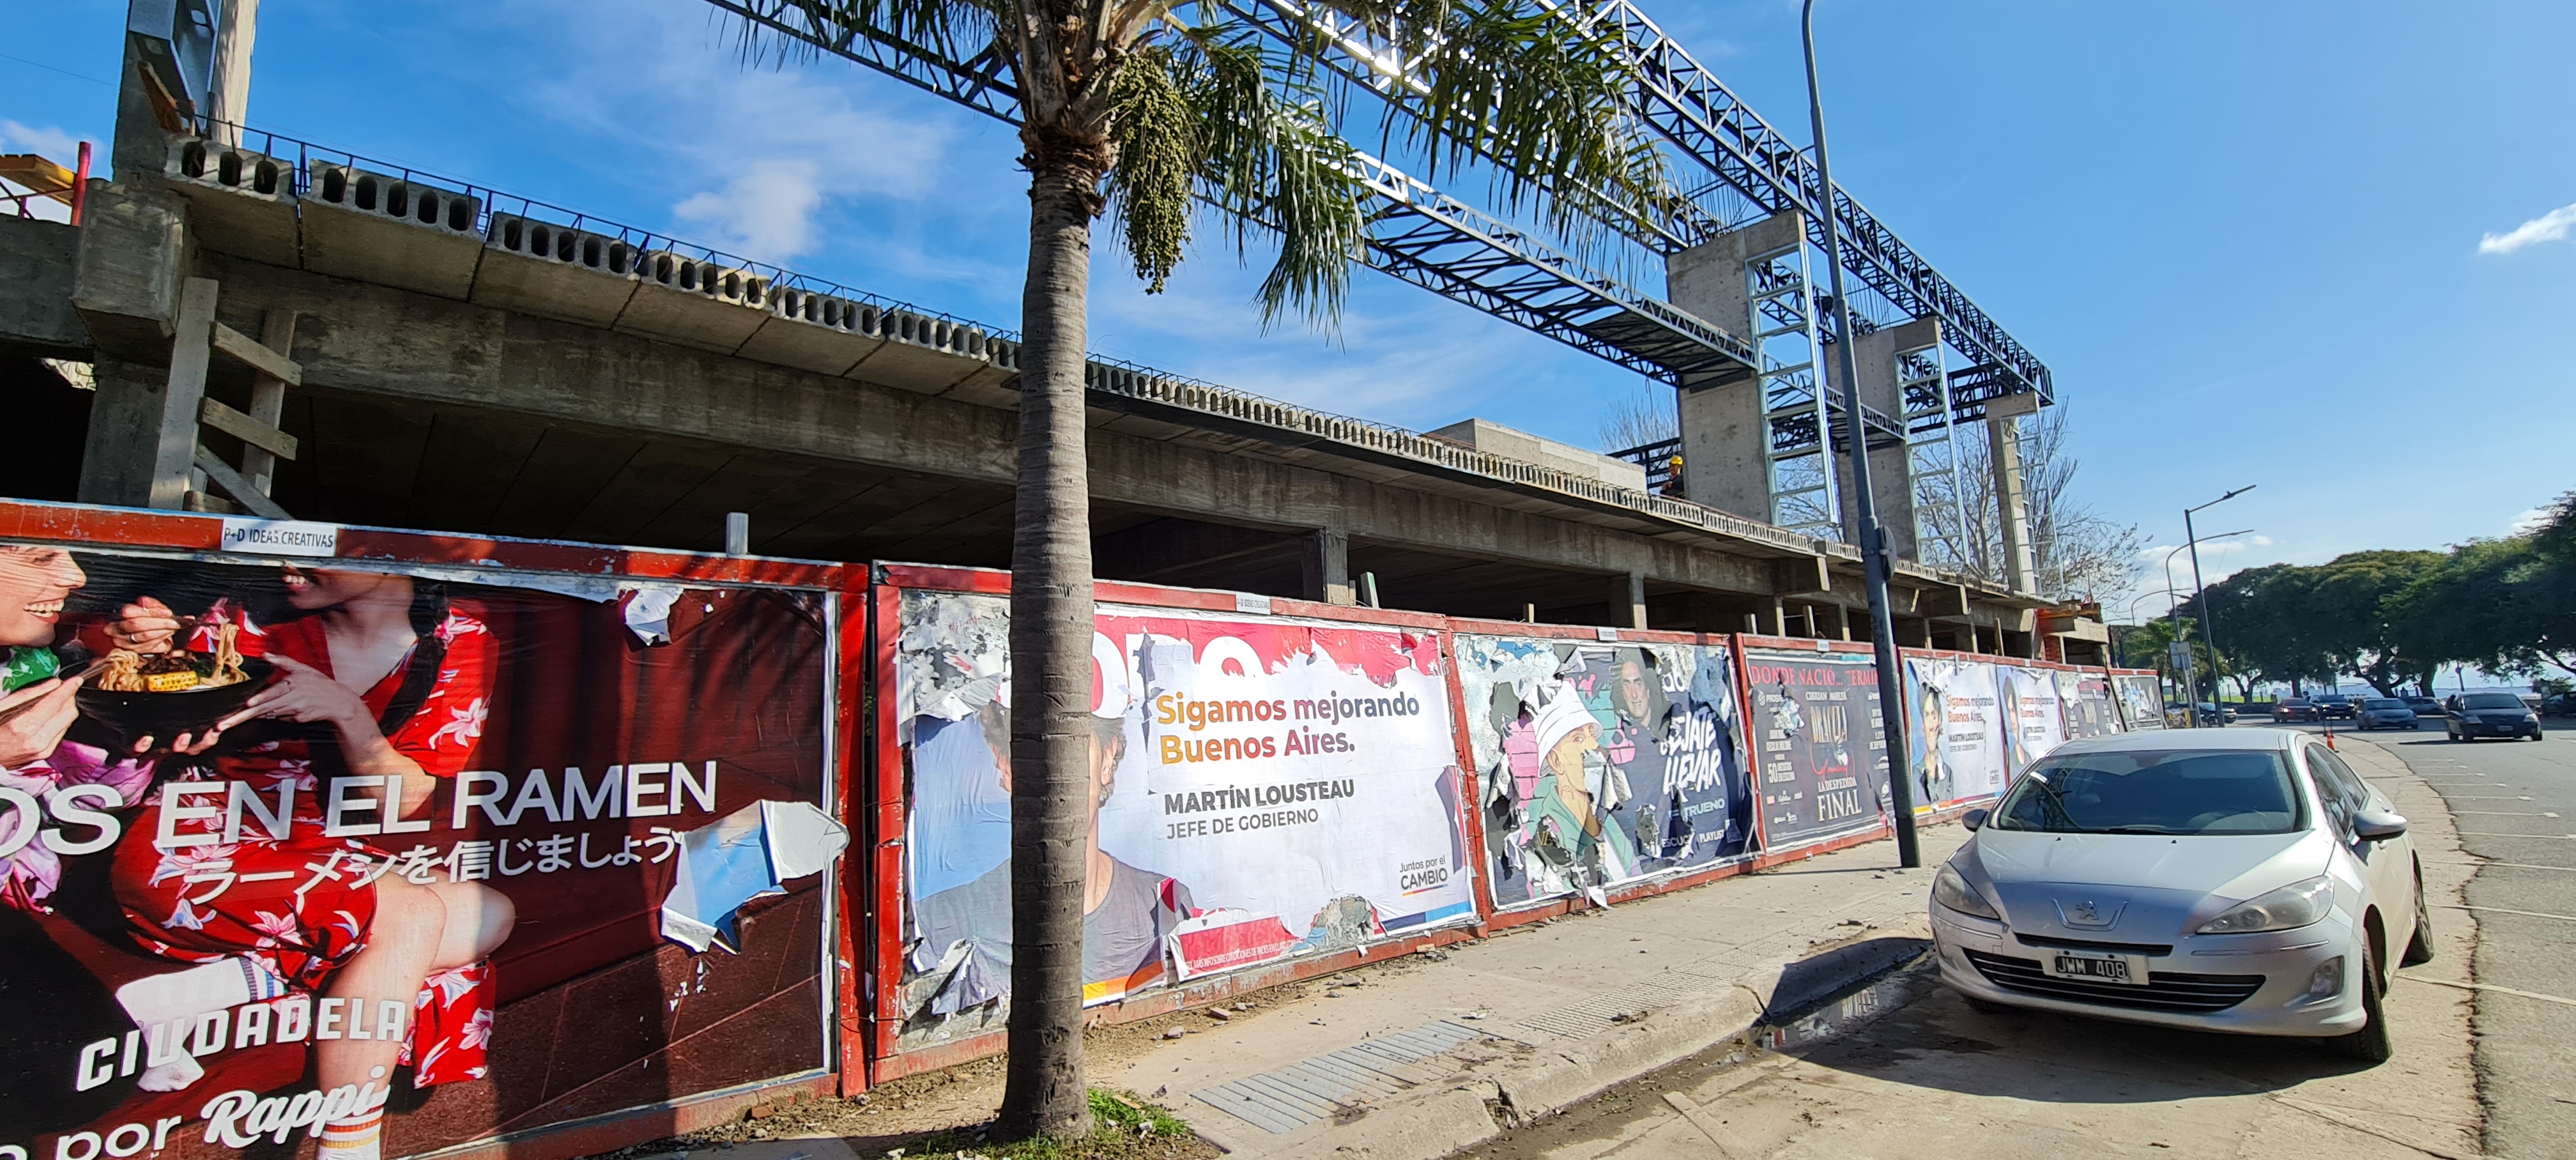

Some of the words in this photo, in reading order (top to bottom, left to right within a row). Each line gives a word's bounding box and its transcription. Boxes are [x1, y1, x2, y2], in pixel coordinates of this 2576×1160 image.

[249, 529, 279, 544] IDEAS
[281, 531, 334, 548] CREATIVAS
[1157, 692, 1287, 731] Sigamos
[1294, 690, 1420, 725] mejorando
[1160, 729, 1276, 765] Buenos
[1284, 726, 1356, 756] Aires.
[1768, 763, 1778, 783] 50
[155, 778, 296, 848] EN
[325, 774, 431, 837] EL
[452, 760, 717, 830] RAMEN
[1165, 785, 1252, 815] MARTÍN
[1256, 779, 1355, 807] LOUSTEAU
[1683, 798, 1725, 817] TRUENO
[1817, 789, 1862, 822] FINAL
[1167, 822, 1208, 839] JEFE
[1213, 818, 1235, 834] DE
[1238, 808, 1319, 831] GOBIERNO
[1661, 834, 1692, 848] ESCUC
[1699, 829, 1724, 843] PLAYLIST
[1400, 861, 1424, 873] Juntos
[1425, 859, 1438, 869] por
[1439, 855, 1446, 865] el
[1401, 867, 1448, 890] CAMBIO
[2096, 960, 2126, 978] 408
[75, 996, 408, 1092] CIUDADELA
[54, 1115, 182, 1160] por
[200, 1065, 392, 1149] Rappi
